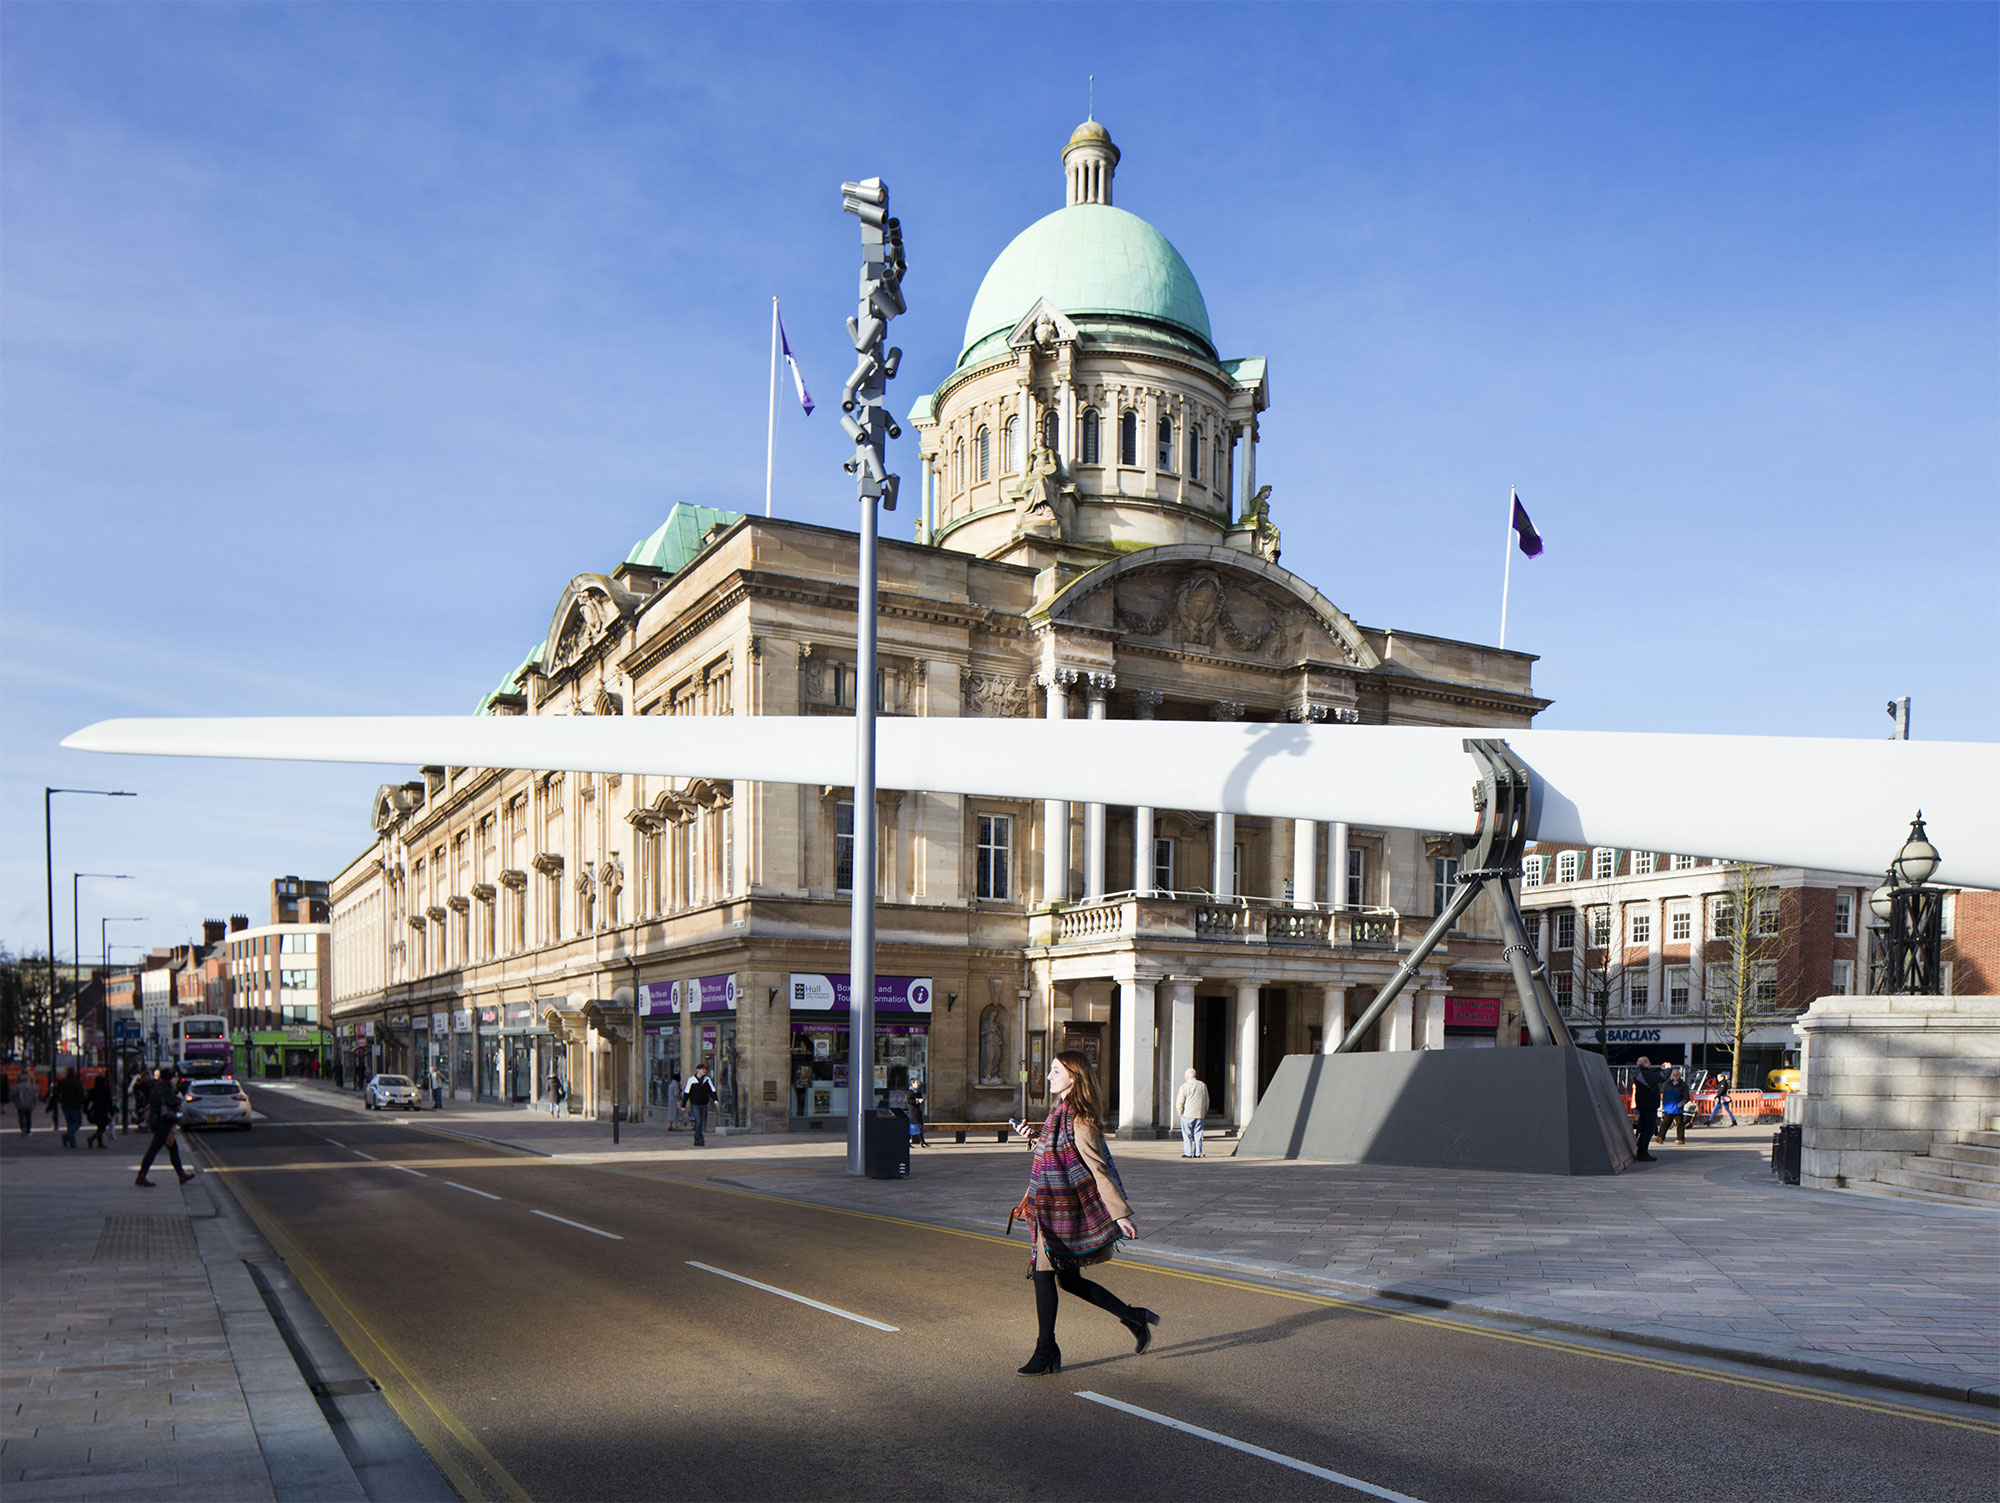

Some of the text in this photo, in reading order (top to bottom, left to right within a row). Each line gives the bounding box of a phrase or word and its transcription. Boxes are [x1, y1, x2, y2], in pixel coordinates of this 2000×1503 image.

[805, 985, 821, 993] Hull
[878, 985, 892, 993] and
[1608, 1029, 1661, 1041] BARCLAYS
